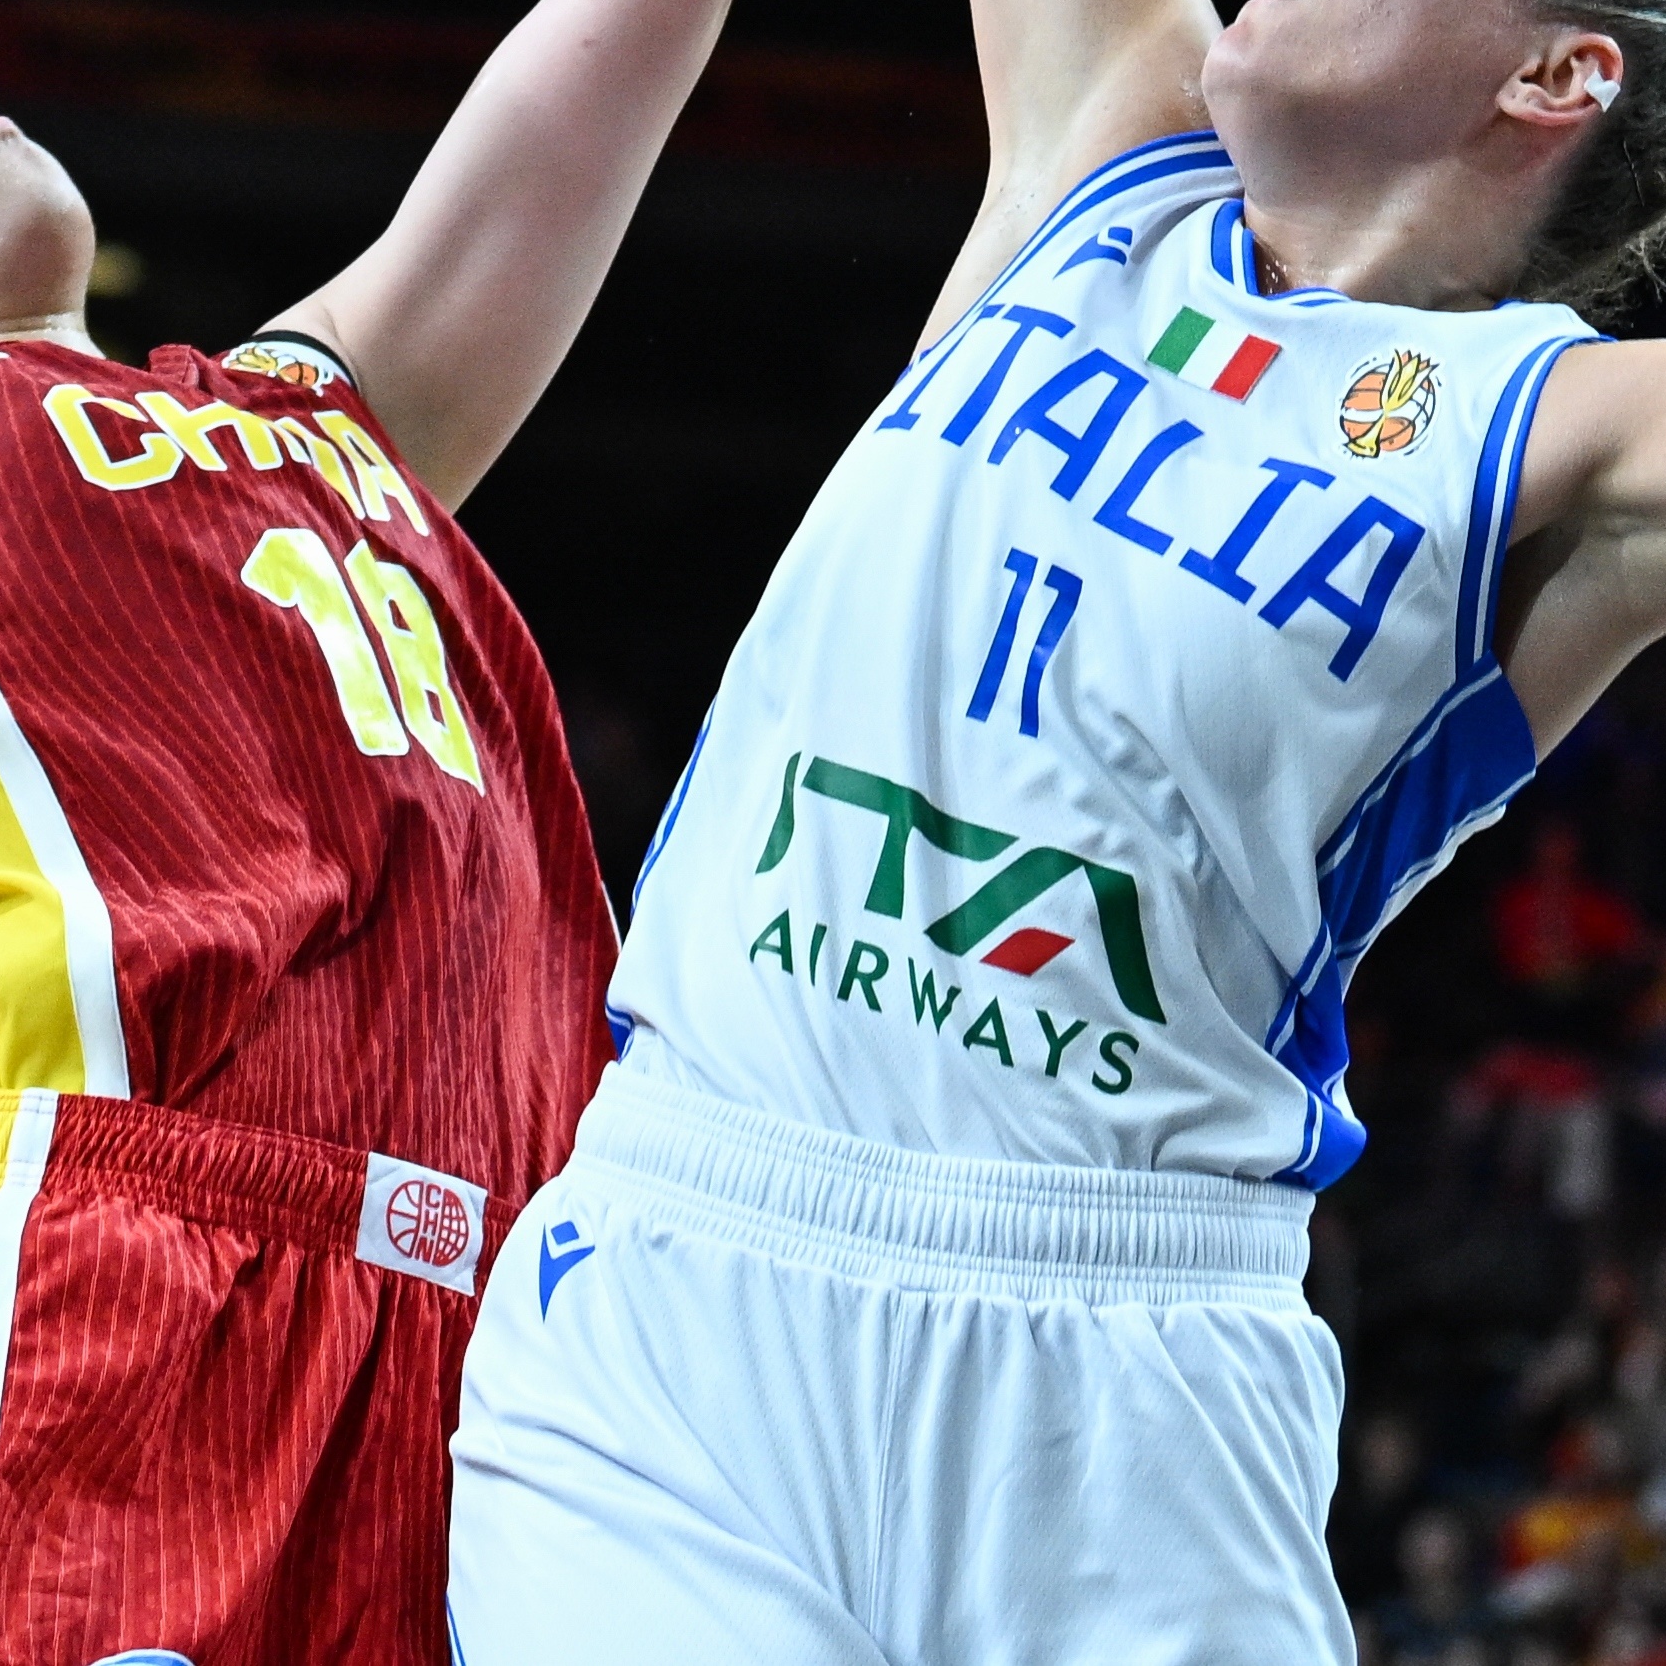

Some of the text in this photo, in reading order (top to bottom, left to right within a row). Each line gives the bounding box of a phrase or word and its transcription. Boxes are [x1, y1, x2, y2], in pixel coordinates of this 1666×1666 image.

[41, 383, 431, 538] CHNA
[874, 303, 1427, 683] ITALIA
[240, 527, 485, 798] 18
[965, 546, 1084, 740] 11
[754, 750, 1168, 1026] ITA
[748, 907, 1141, 1096] AIRWAYS
[414, 1182, 442, 1263] CHN
